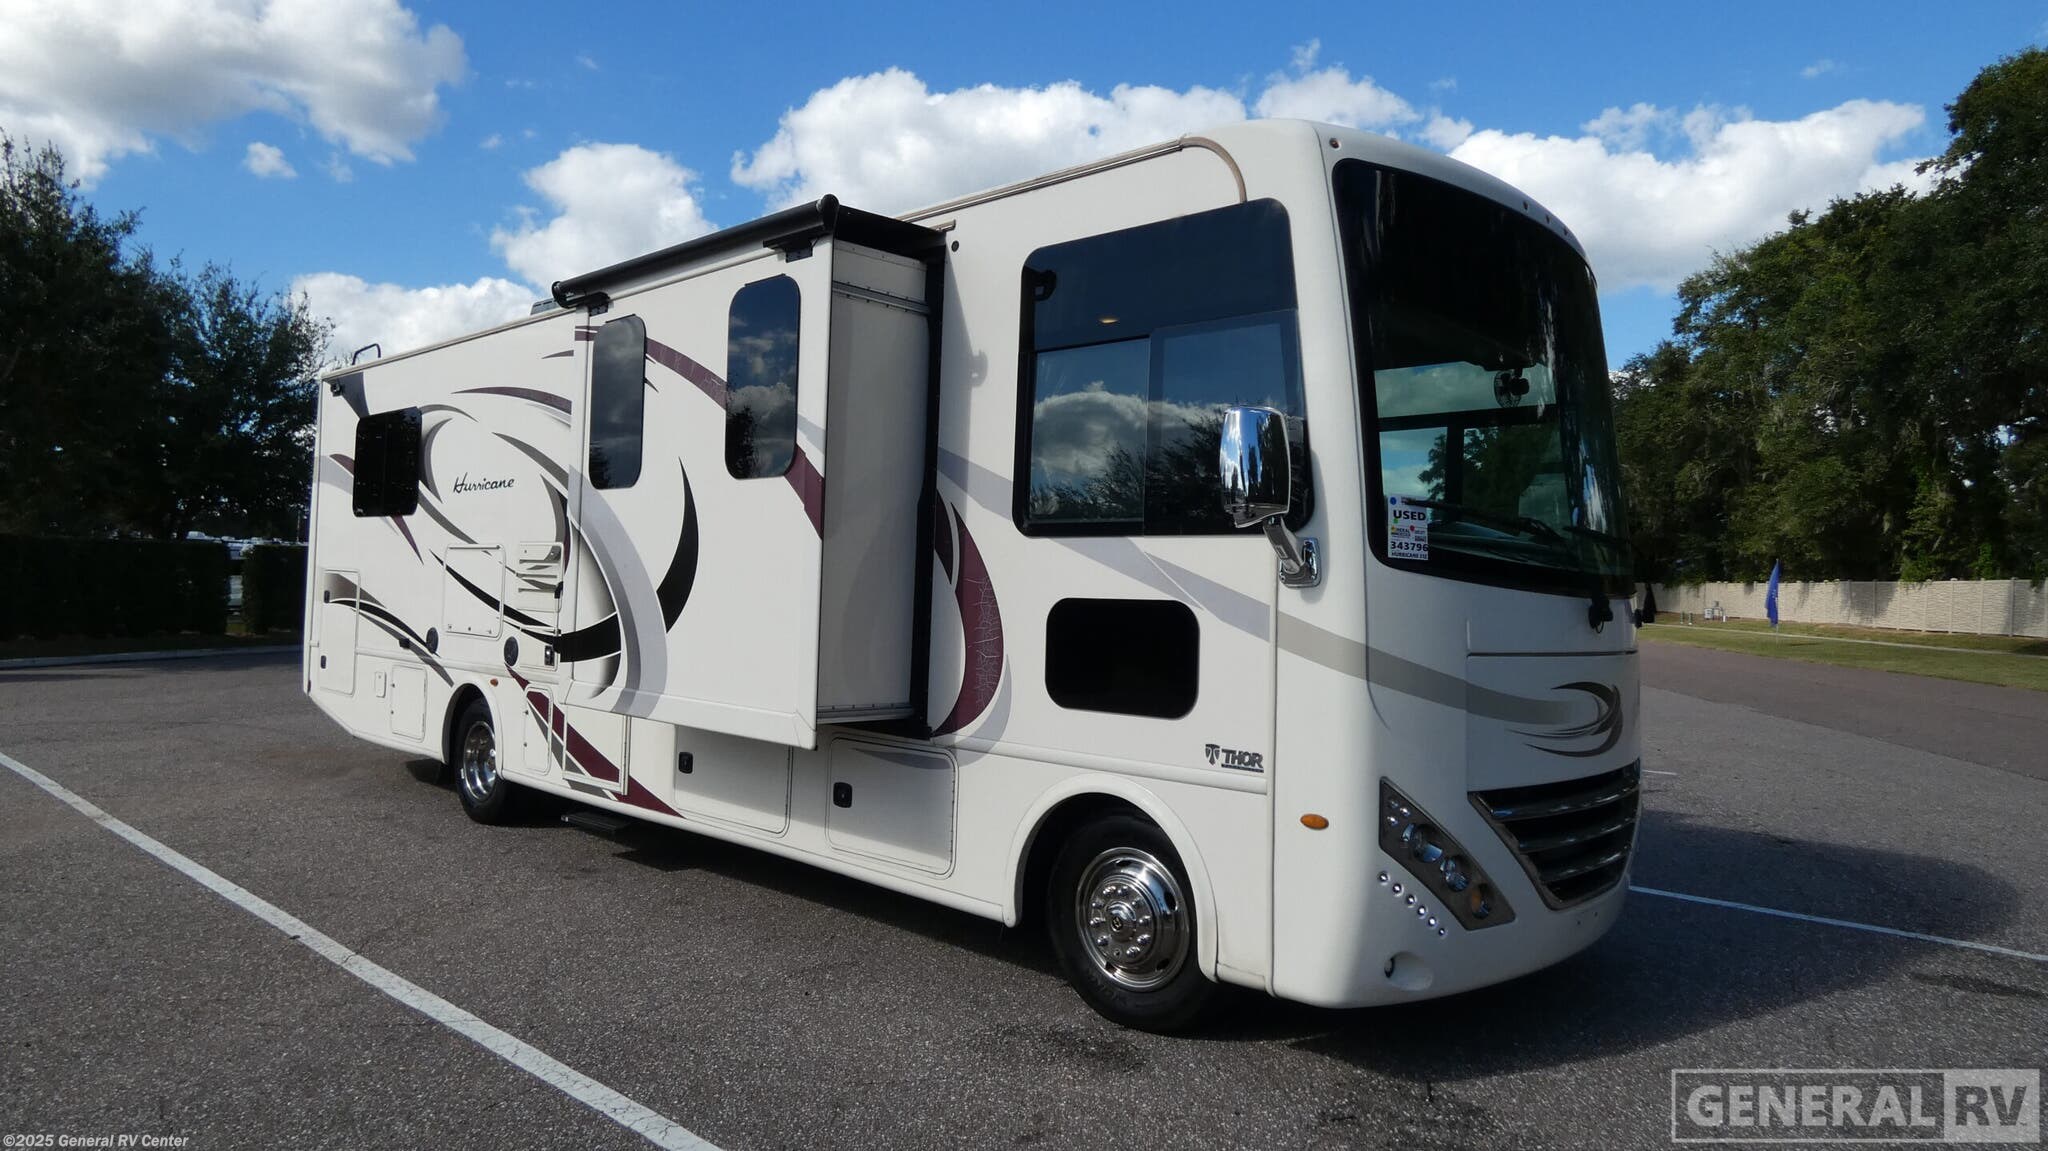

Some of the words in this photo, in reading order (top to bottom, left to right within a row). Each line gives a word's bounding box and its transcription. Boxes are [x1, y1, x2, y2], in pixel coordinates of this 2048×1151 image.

[452, 472, 515, 494] Hurricane
[1393, 510, 1427, 521] USED
[1391, 541, 1430, 552] 343796
[1221, 748, 1264, 769] THOR
